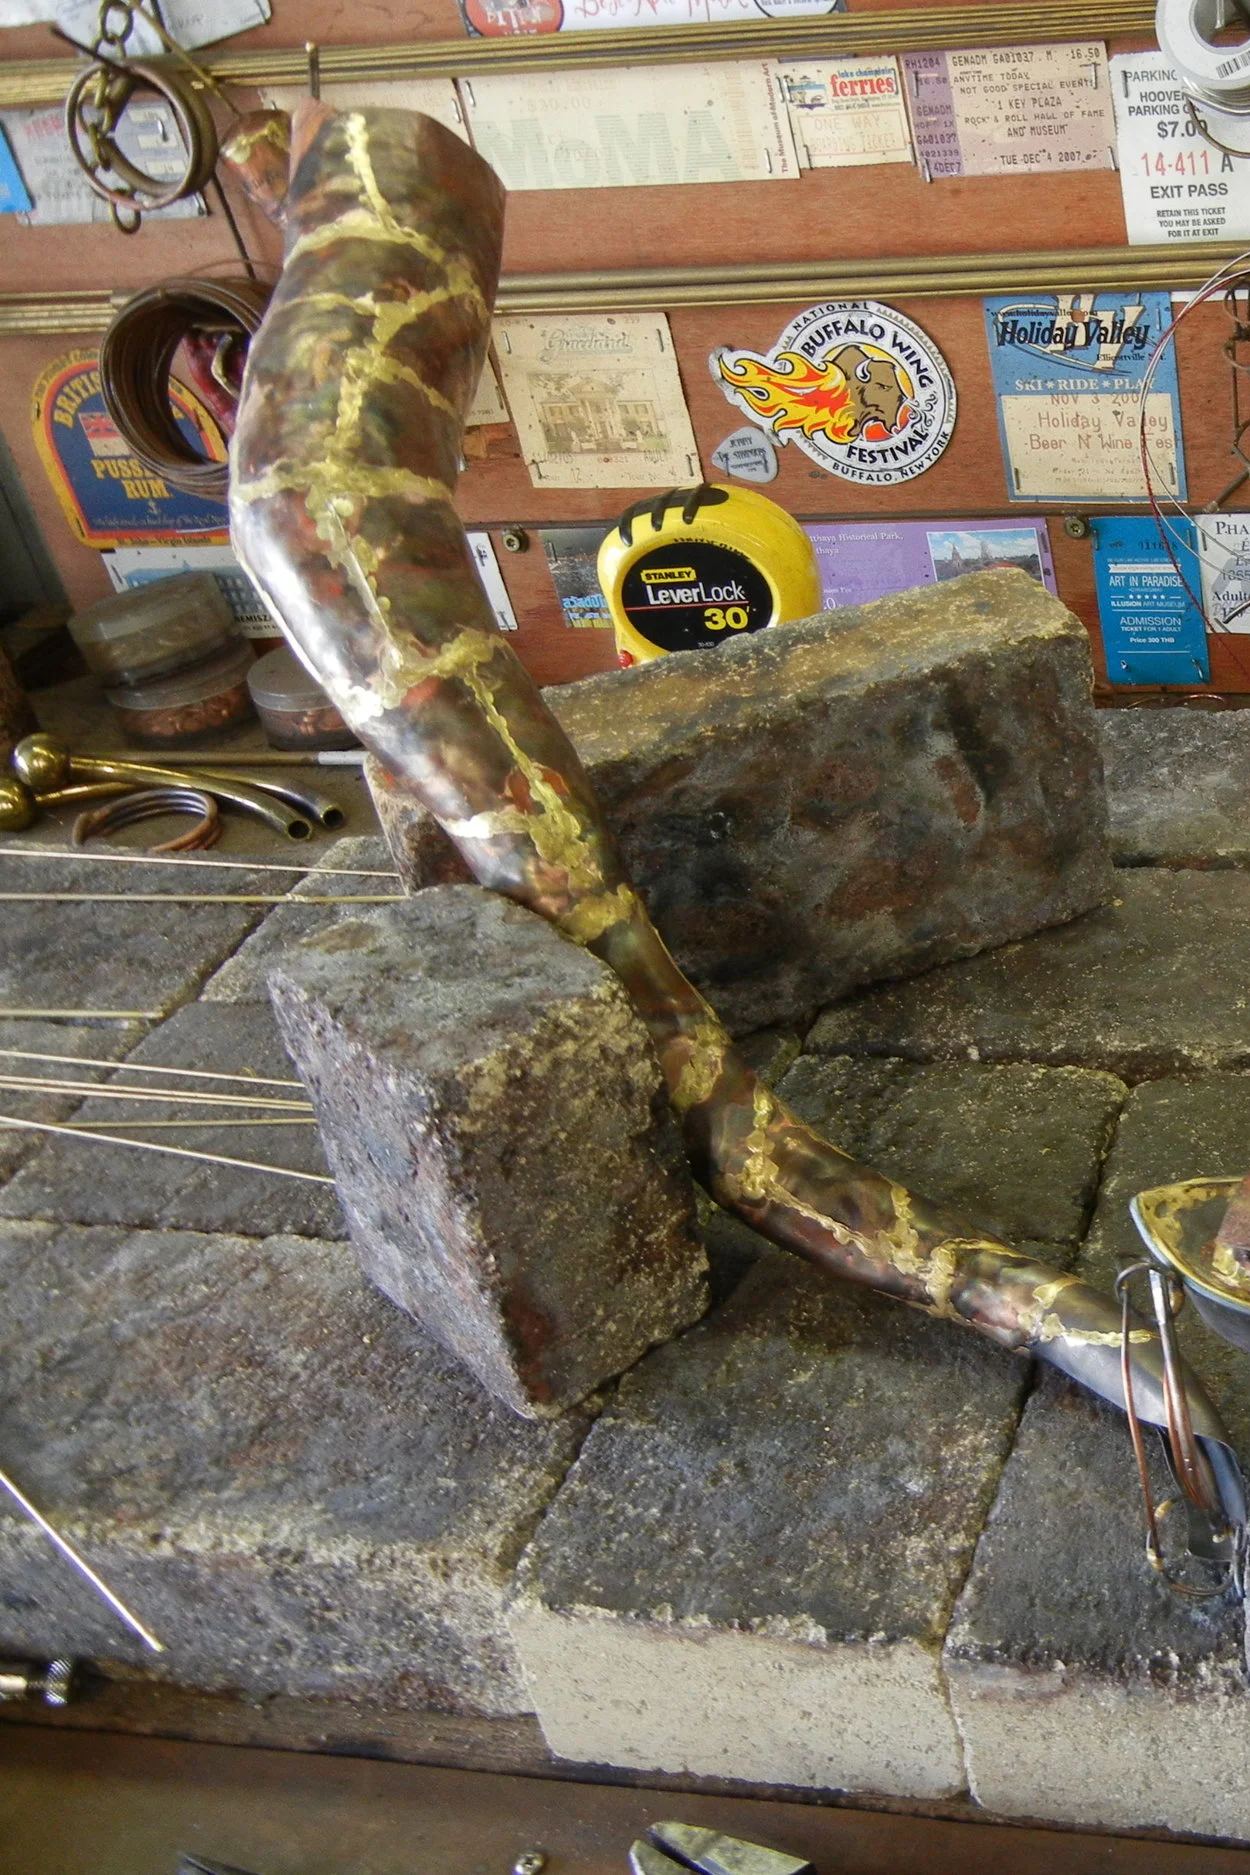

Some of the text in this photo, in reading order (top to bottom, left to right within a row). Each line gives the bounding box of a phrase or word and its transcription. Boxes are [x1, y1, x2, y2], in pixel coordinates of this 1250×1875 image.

[952, 55, 987, 66] GENADM
[830, 74, 894, 97] ferries
[960, 82, 1053, 94] NOT GOOD SPECIAL
[765, 78, 776, 113] Modern
[1009, 97, 1062, 109] KEY PLAZA
[1128, 104, 1178, 116] PARKING
[1005, 114, 1028, 122] ROLL
[1008, 125, 1066, 137] AND MUSEUM
[1157, 120, 1208, 139] $7.00
[774, 124, 786, 158] Museum
[474, 110, 744, 190] MoMA
[1001, 151, 1081, 165] TUE DEC 2007
[1220, 153, 1234, 173] A
[780, 160, 789, 173] The
[1151, 183, 1228, 199] EXIT PASS
[1157, 209, 1181, 217] RETAIN
[1201, 207, 1226, 215] TICKET
[1175, 219, 1188, 227] MAY
[793, 301, 870, 331] NATIONAL
[997, 320, 1150, 350] Holiday Valley
[802, 320, 933, 390] BUFFALO WING
[1015, 379, 1099, 391] SKI RIDE
[1051, 395, 1079, 405] NOV
[1039, 412, 1100, 432] Holiday
[847, 430, 929, 464] FESTIVAL
[1029, 434, 1133, 449] Beer Wine
[900, 461, 925, 478] NEW
[925, 431, 949, 462] YORK
[838, 531, 878, 541] Historical
[644, 570, 694, 582] STANLEY
[1109, 576, 1183, 587] ART IN PARADISE
[647, 580, 745, 606] LeverLock
[1120, 616, 1181, 625] ADMISSION
